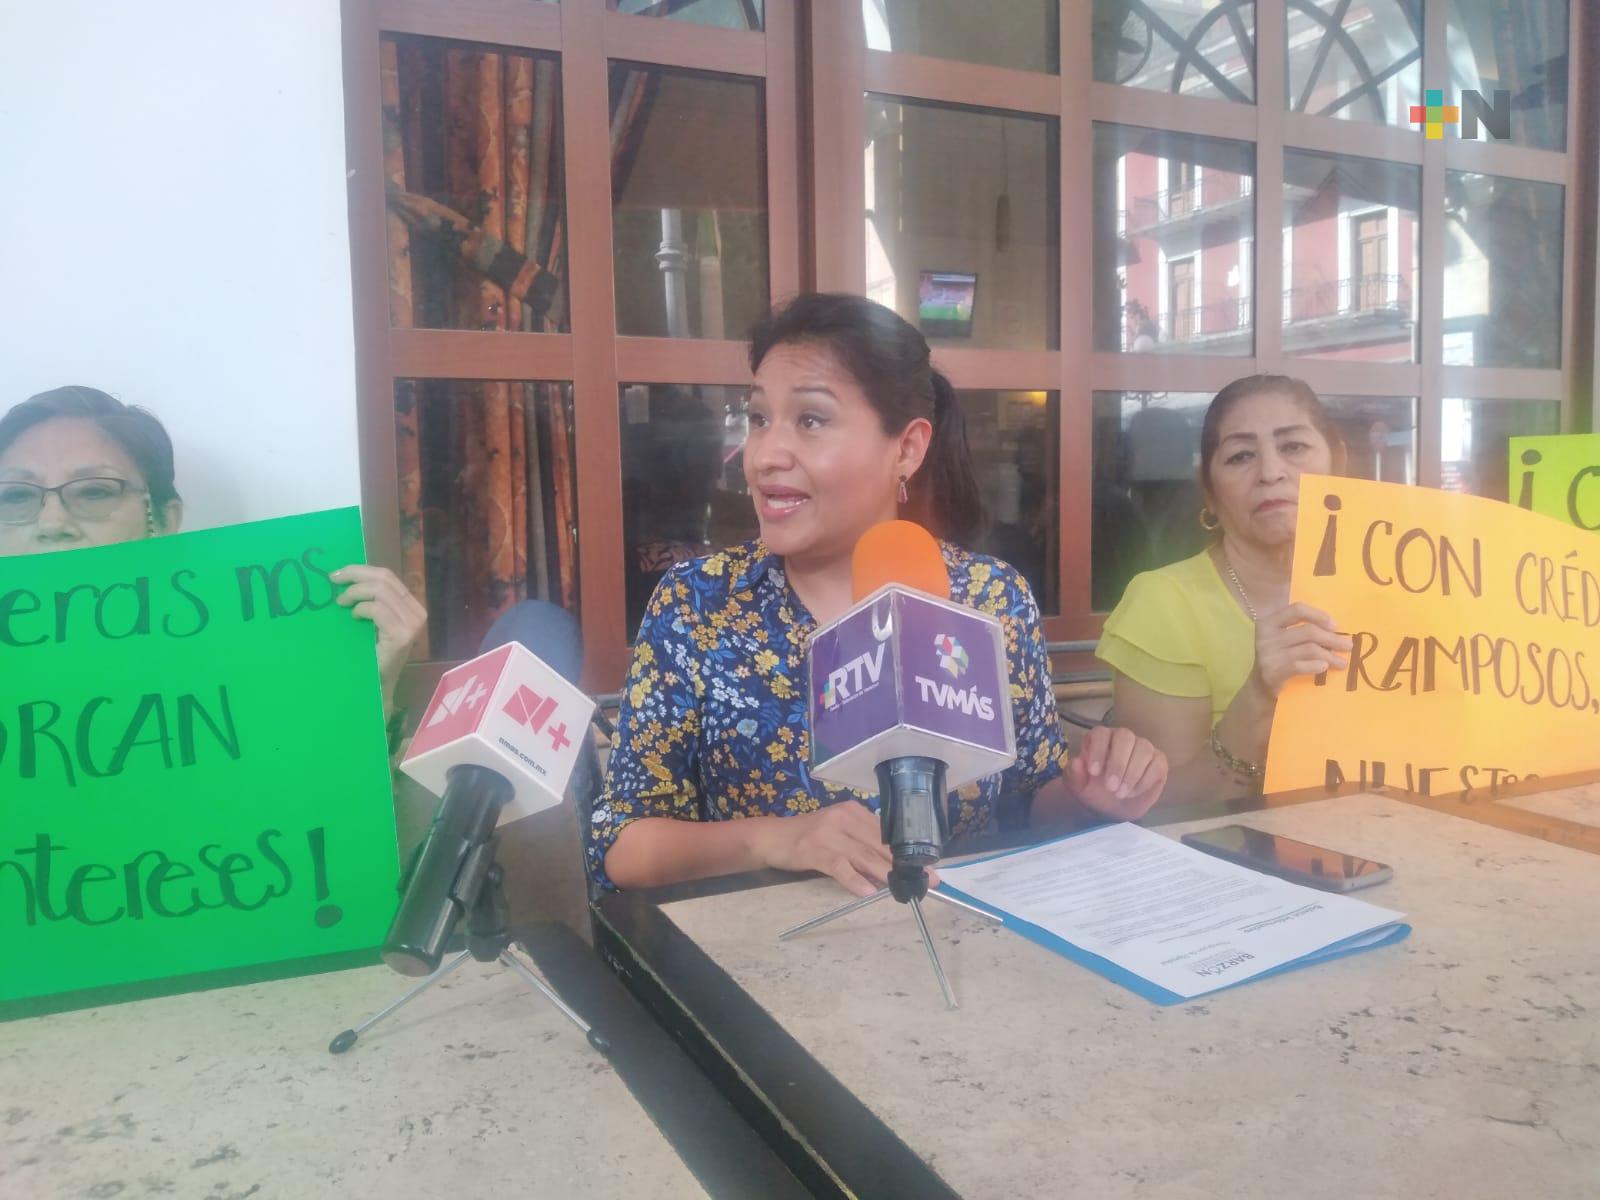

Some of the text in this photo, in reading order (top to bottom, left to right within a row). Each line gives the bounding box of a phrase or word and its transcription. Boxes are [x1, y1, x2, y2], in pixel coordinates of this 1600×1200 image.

[1313, 494, 1483, 598] ¡CON
[235, 547, 341, 623] nos
[823, 643, 885, 709] RTV
[915, 675, 995, 721] TVMÁS
[0, 684, 241, 787] RCAN
